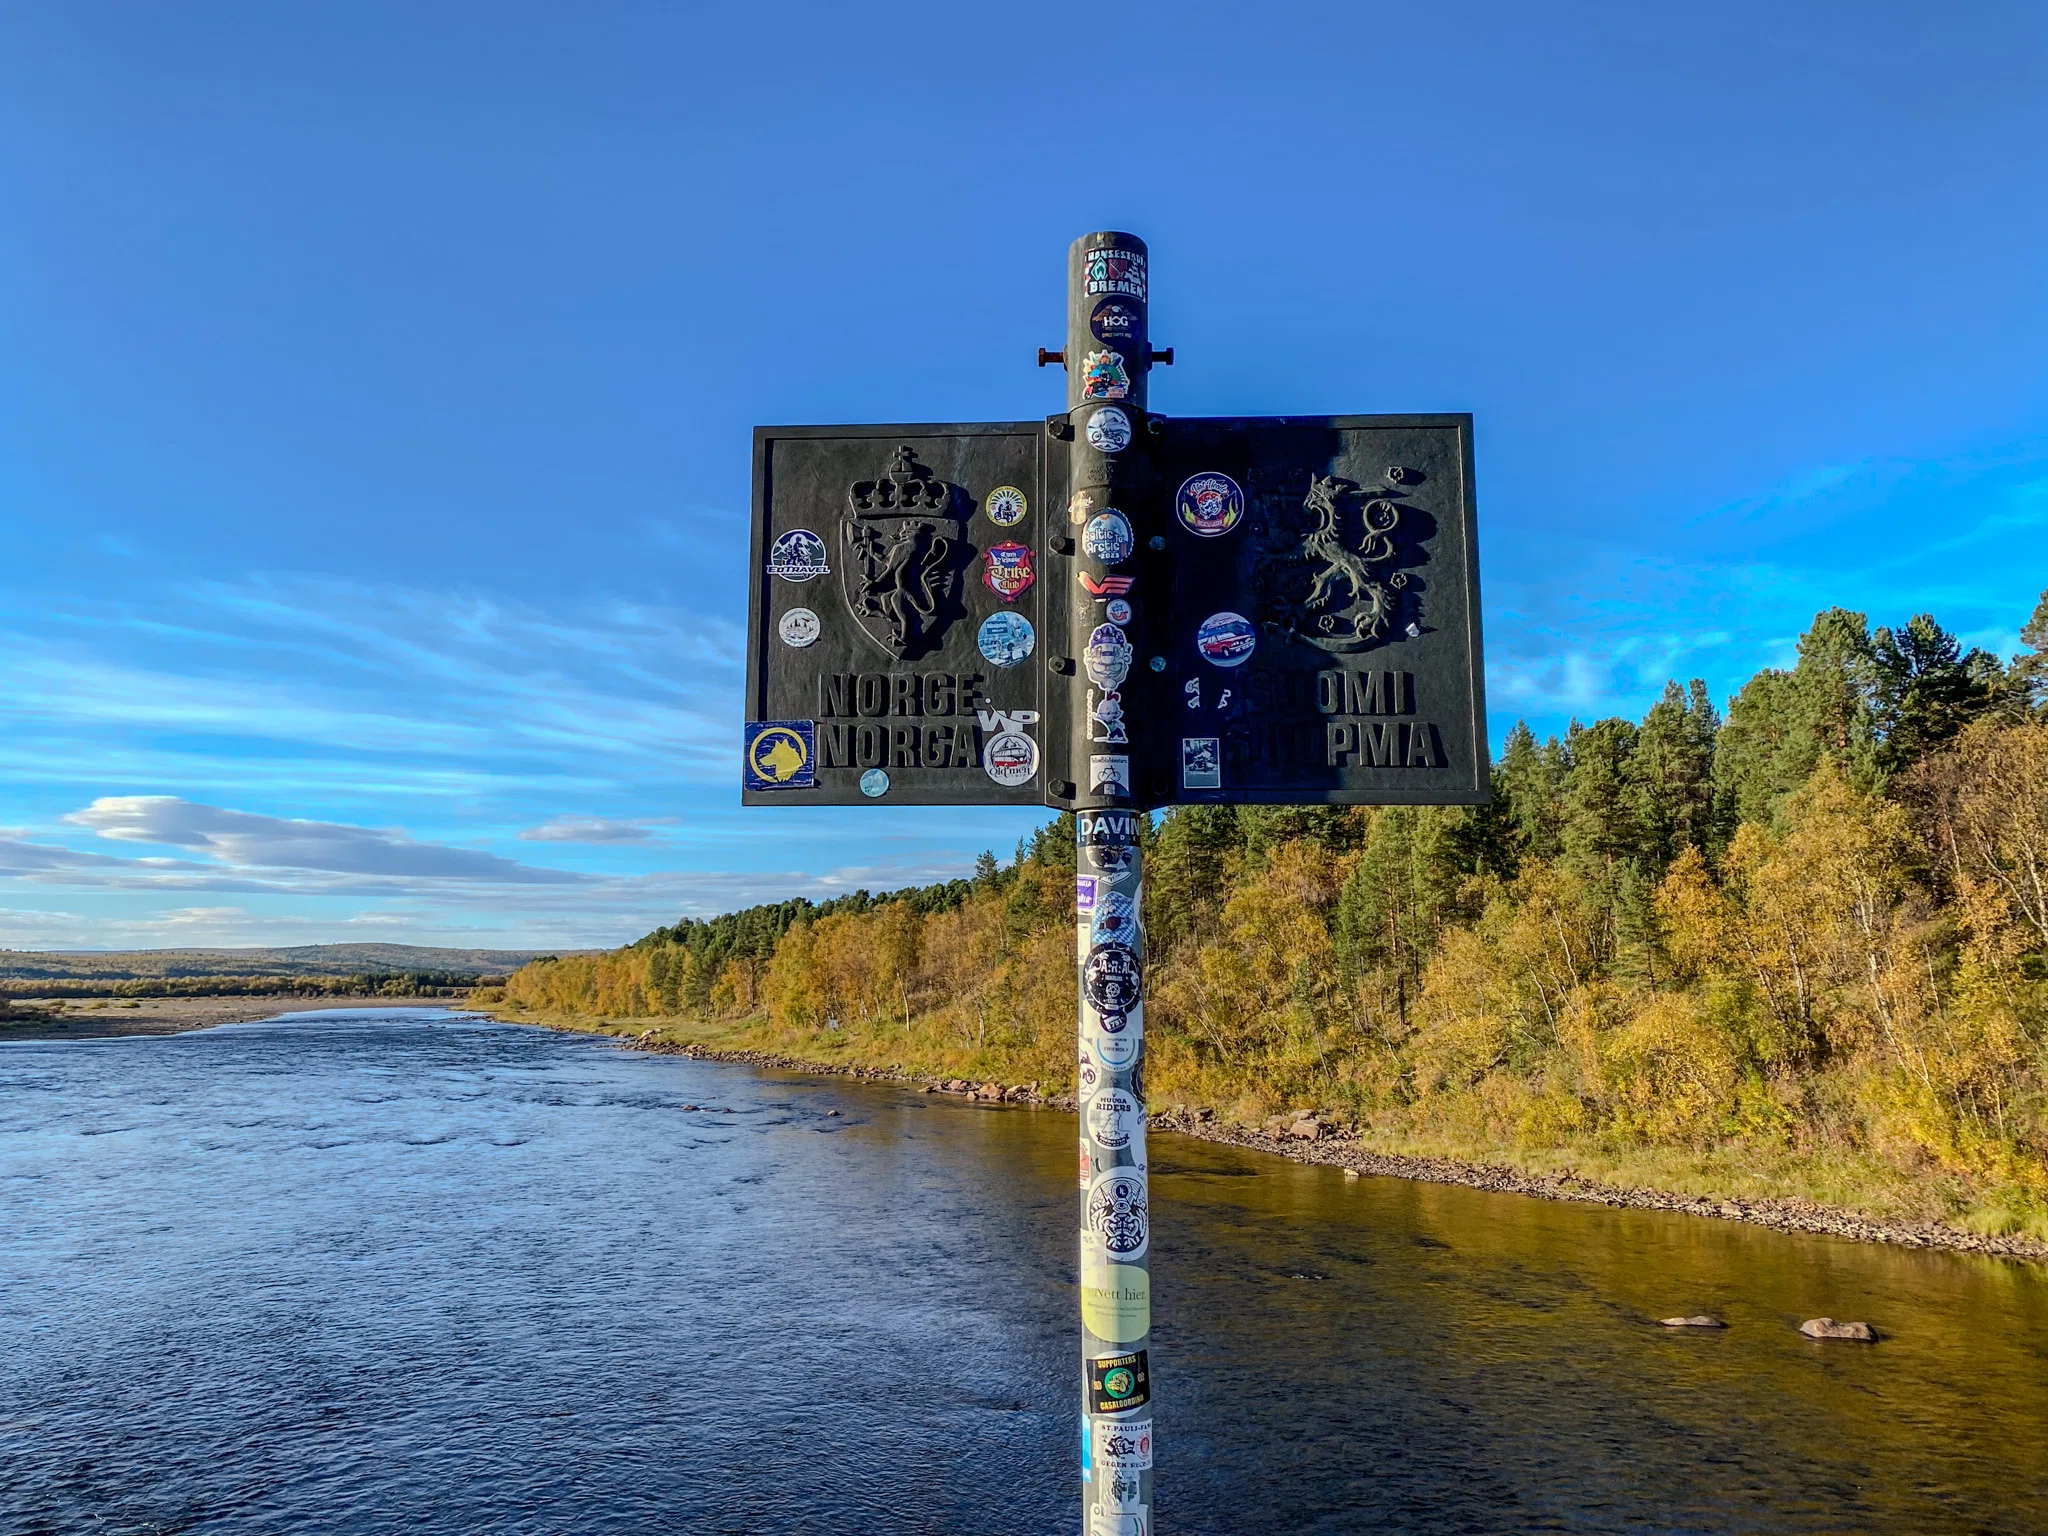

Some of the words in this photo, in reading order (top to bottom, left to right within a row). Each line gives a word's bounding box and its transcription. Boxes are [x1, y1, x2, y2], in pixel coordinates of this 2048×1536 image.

[1089, 280, 1143, 299] BREMEN
[1103, 315, 1129, 327] HOG
[818, 673, 976, 717] NORGE
[818, 724, 978, 768] NORGA
[1096, 1103, 1131, 1112] RIDERS
[1095, 1289, 1120, 1300] Nett
[1124, 1288, 1146, 1301] hier.
[1098, 1355, 1137, 1369] SUPPORTERS
